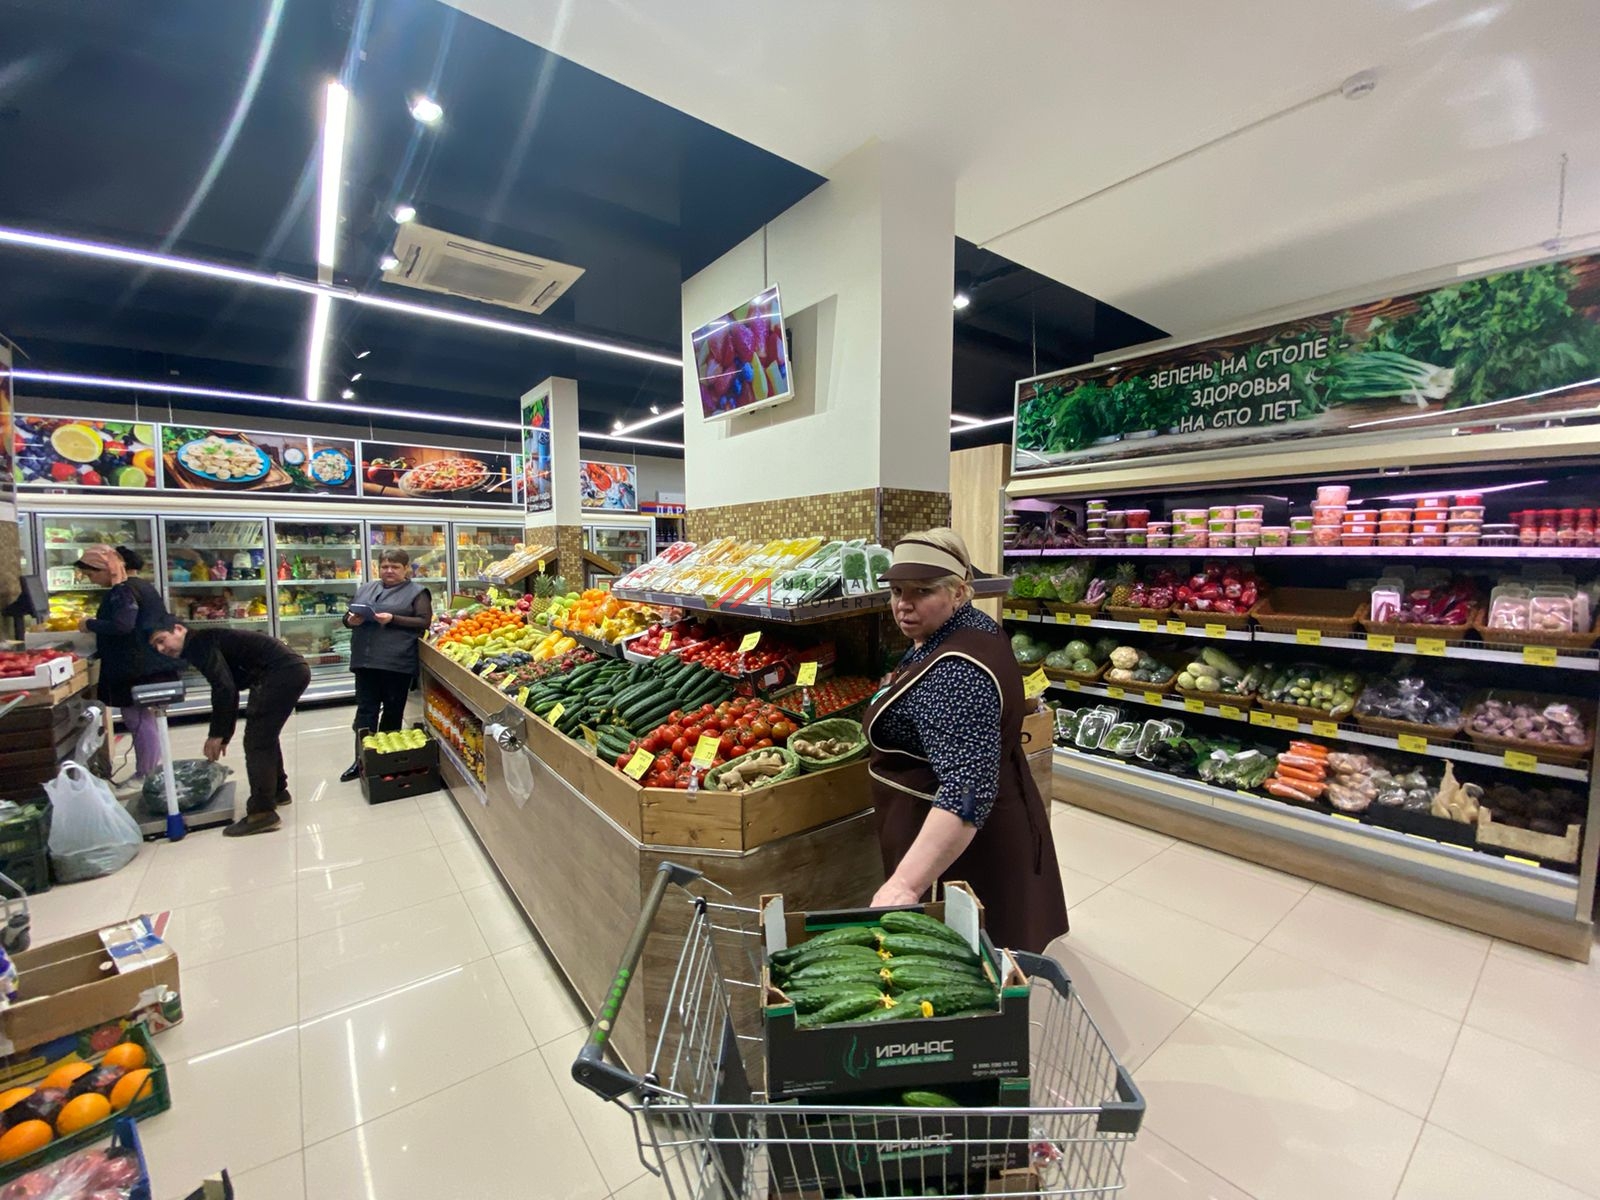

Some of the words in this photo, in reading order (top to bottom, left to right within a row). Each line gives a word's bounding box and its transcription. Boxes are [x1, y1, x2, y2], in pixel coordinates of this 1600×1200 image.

[1148, 363, 1213, 390] ЗЕЛЕНЬ
[1220, 356, 1247, 376] НА
[1256, 337, 1328, 368] СТОЛЕ
[1191, 373, 1291, 407] ЗДОРОВЬЯ
[1180, 415, 1205, 433] НА
[1212, 407, 1251, 428] СТО
[1259, 399, 1302, 422] ЛЕТ
[876, 1040, 954, 1058] ИРИНАС
